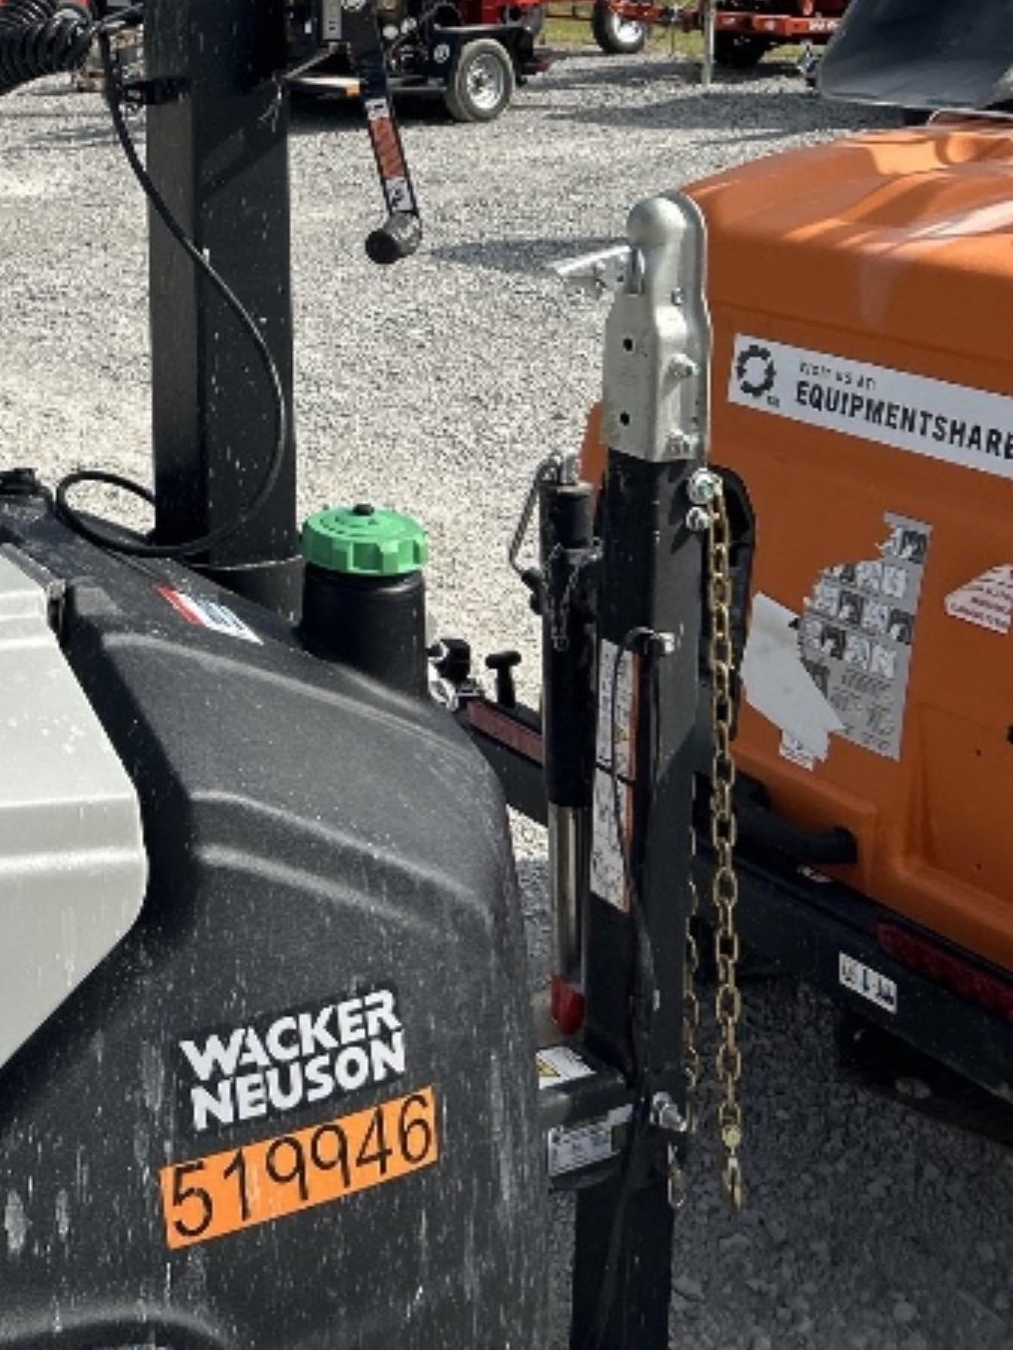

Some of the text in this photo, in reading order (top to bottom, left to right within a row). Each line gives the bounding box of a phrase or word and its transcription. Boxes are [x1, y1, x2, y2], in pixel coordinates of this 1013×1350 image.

[179, 989, 402, 1081] WACKER
[190, 1031, 406, 1132] NEUSON
[171, 1094, 433, 1238] 519946
